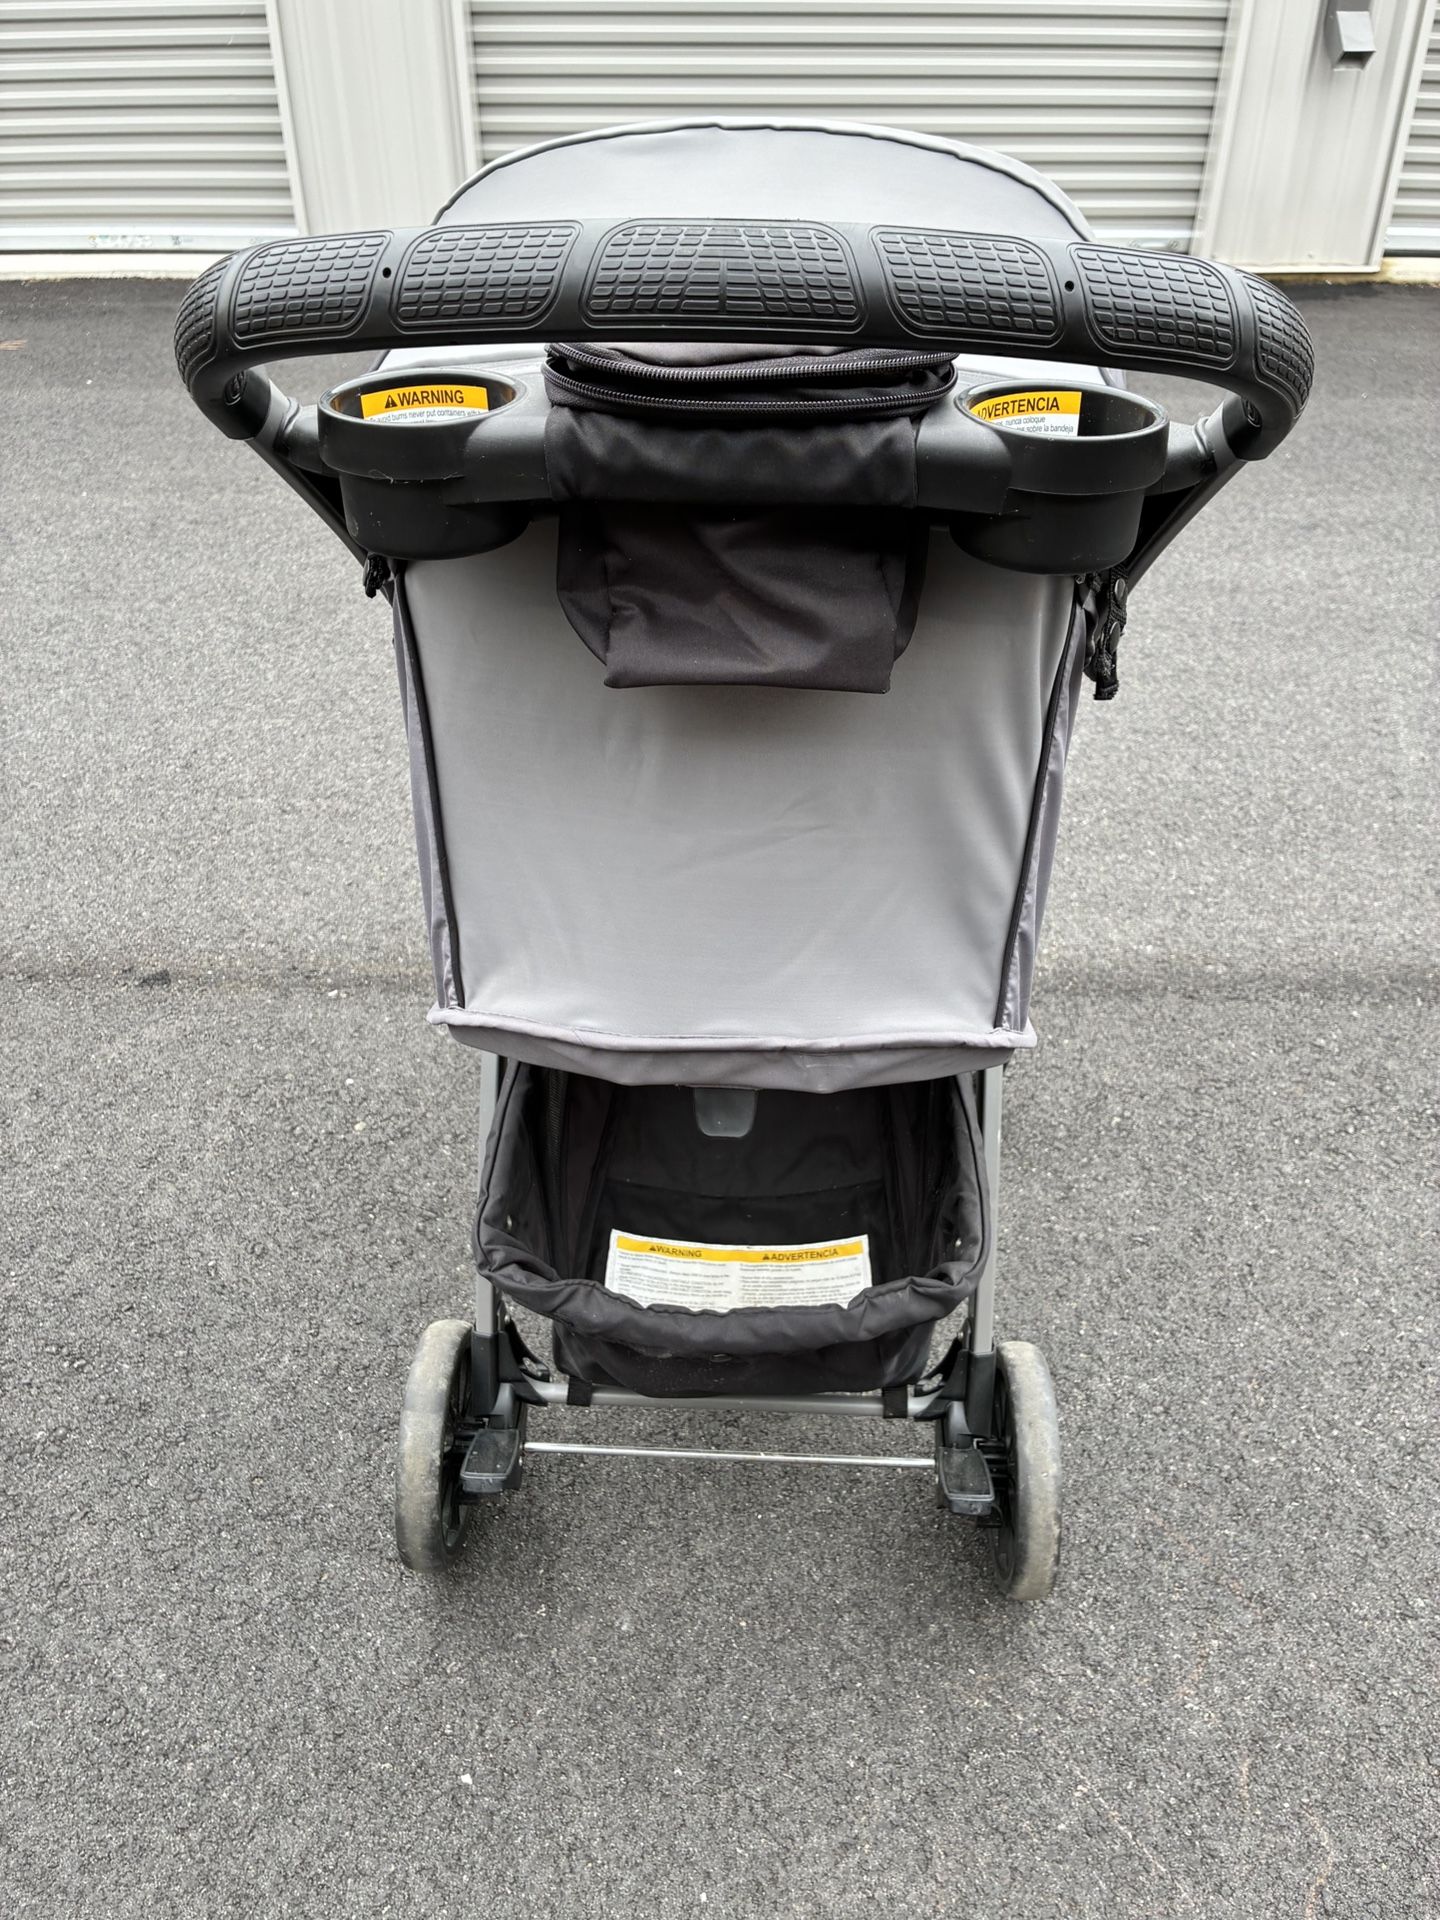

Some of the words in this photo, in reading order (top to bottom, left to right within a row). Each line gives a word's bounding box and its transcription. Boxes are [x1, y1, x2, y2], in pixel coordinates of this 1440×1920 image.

[397, 390, 464, 406] WARNING
[391, 411, 408, 421] burns
[408, 410, 425, 418] never
[425, 409, 436, 418] put
[436, 408, 466, 417] containers
[1005, 417, 1022, 426] nunca
[1022, 415, 1046, 425] coloque
[1026, 424, 1043, 433] sobre
[1043, 423, 1050, 432] la
[1050, 424, 1074, 434] bandeja
[656, 1245, 703, 1258] WARNING
[771, 1248, 839, 1261] ADVERTENCIA
